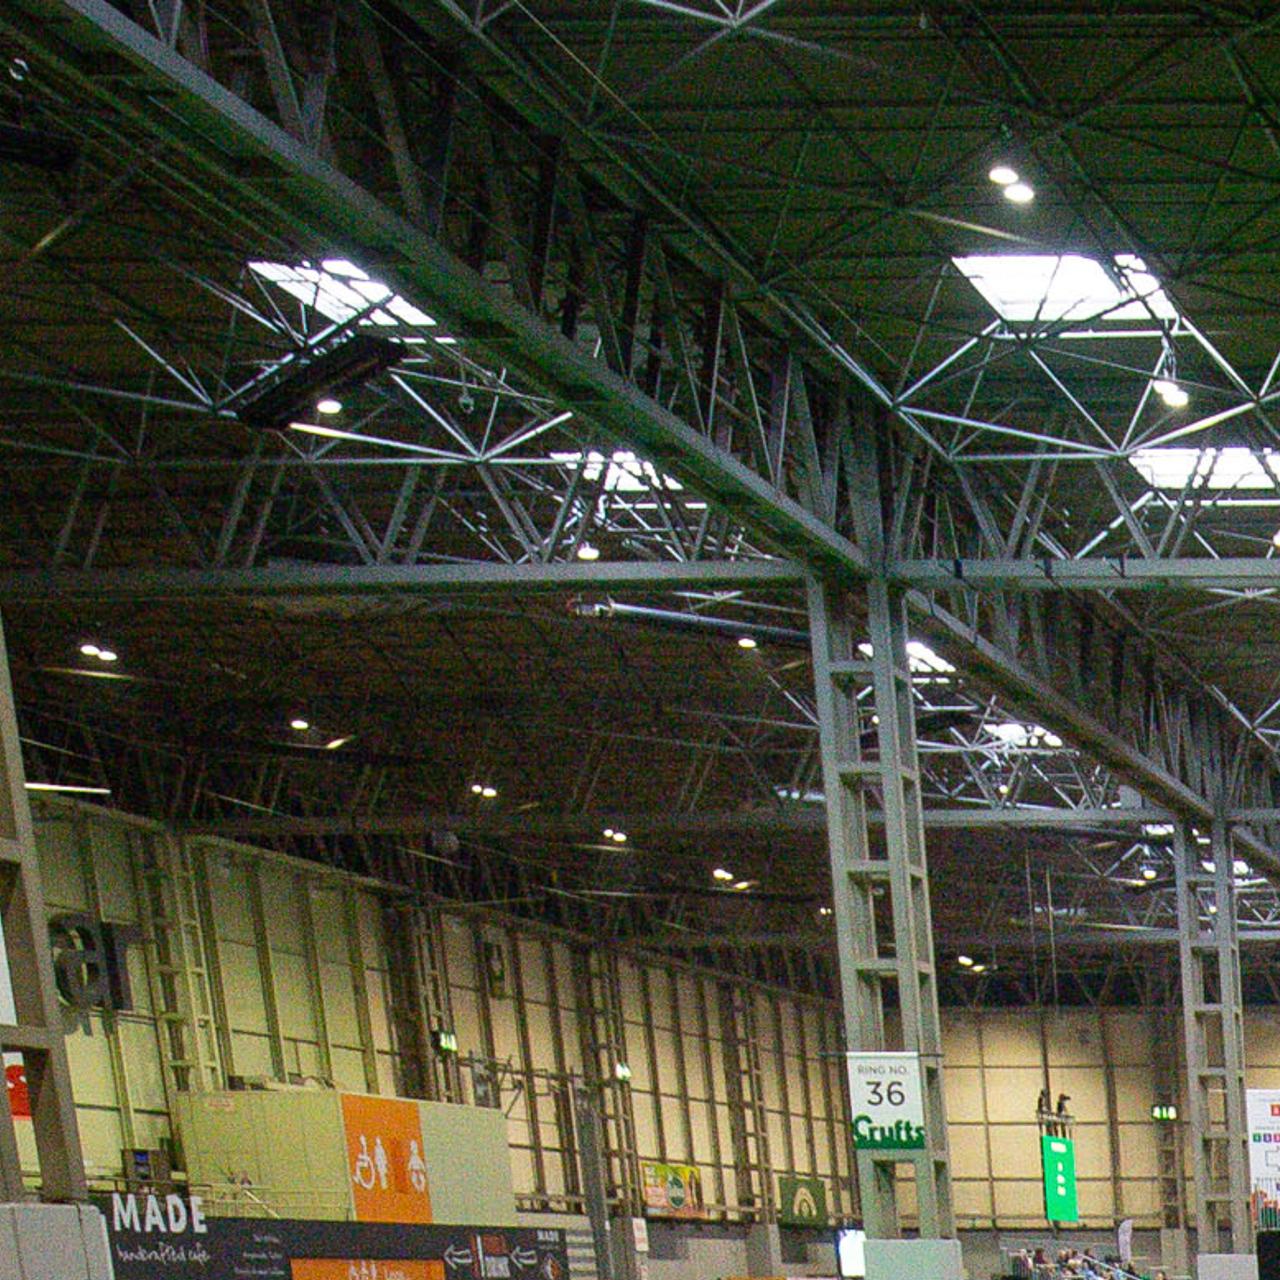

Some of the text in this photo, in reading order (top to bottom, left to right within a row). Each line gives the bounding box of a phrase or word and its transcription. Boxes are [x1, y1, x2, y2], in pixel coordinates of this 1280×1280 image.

[857, 1065, 886, 1075] RING
[866, 1081, 906, 1106] 36
[853, 1114, 925, 1141] Crufts
[112, 1192, 208, 1234] MADE
